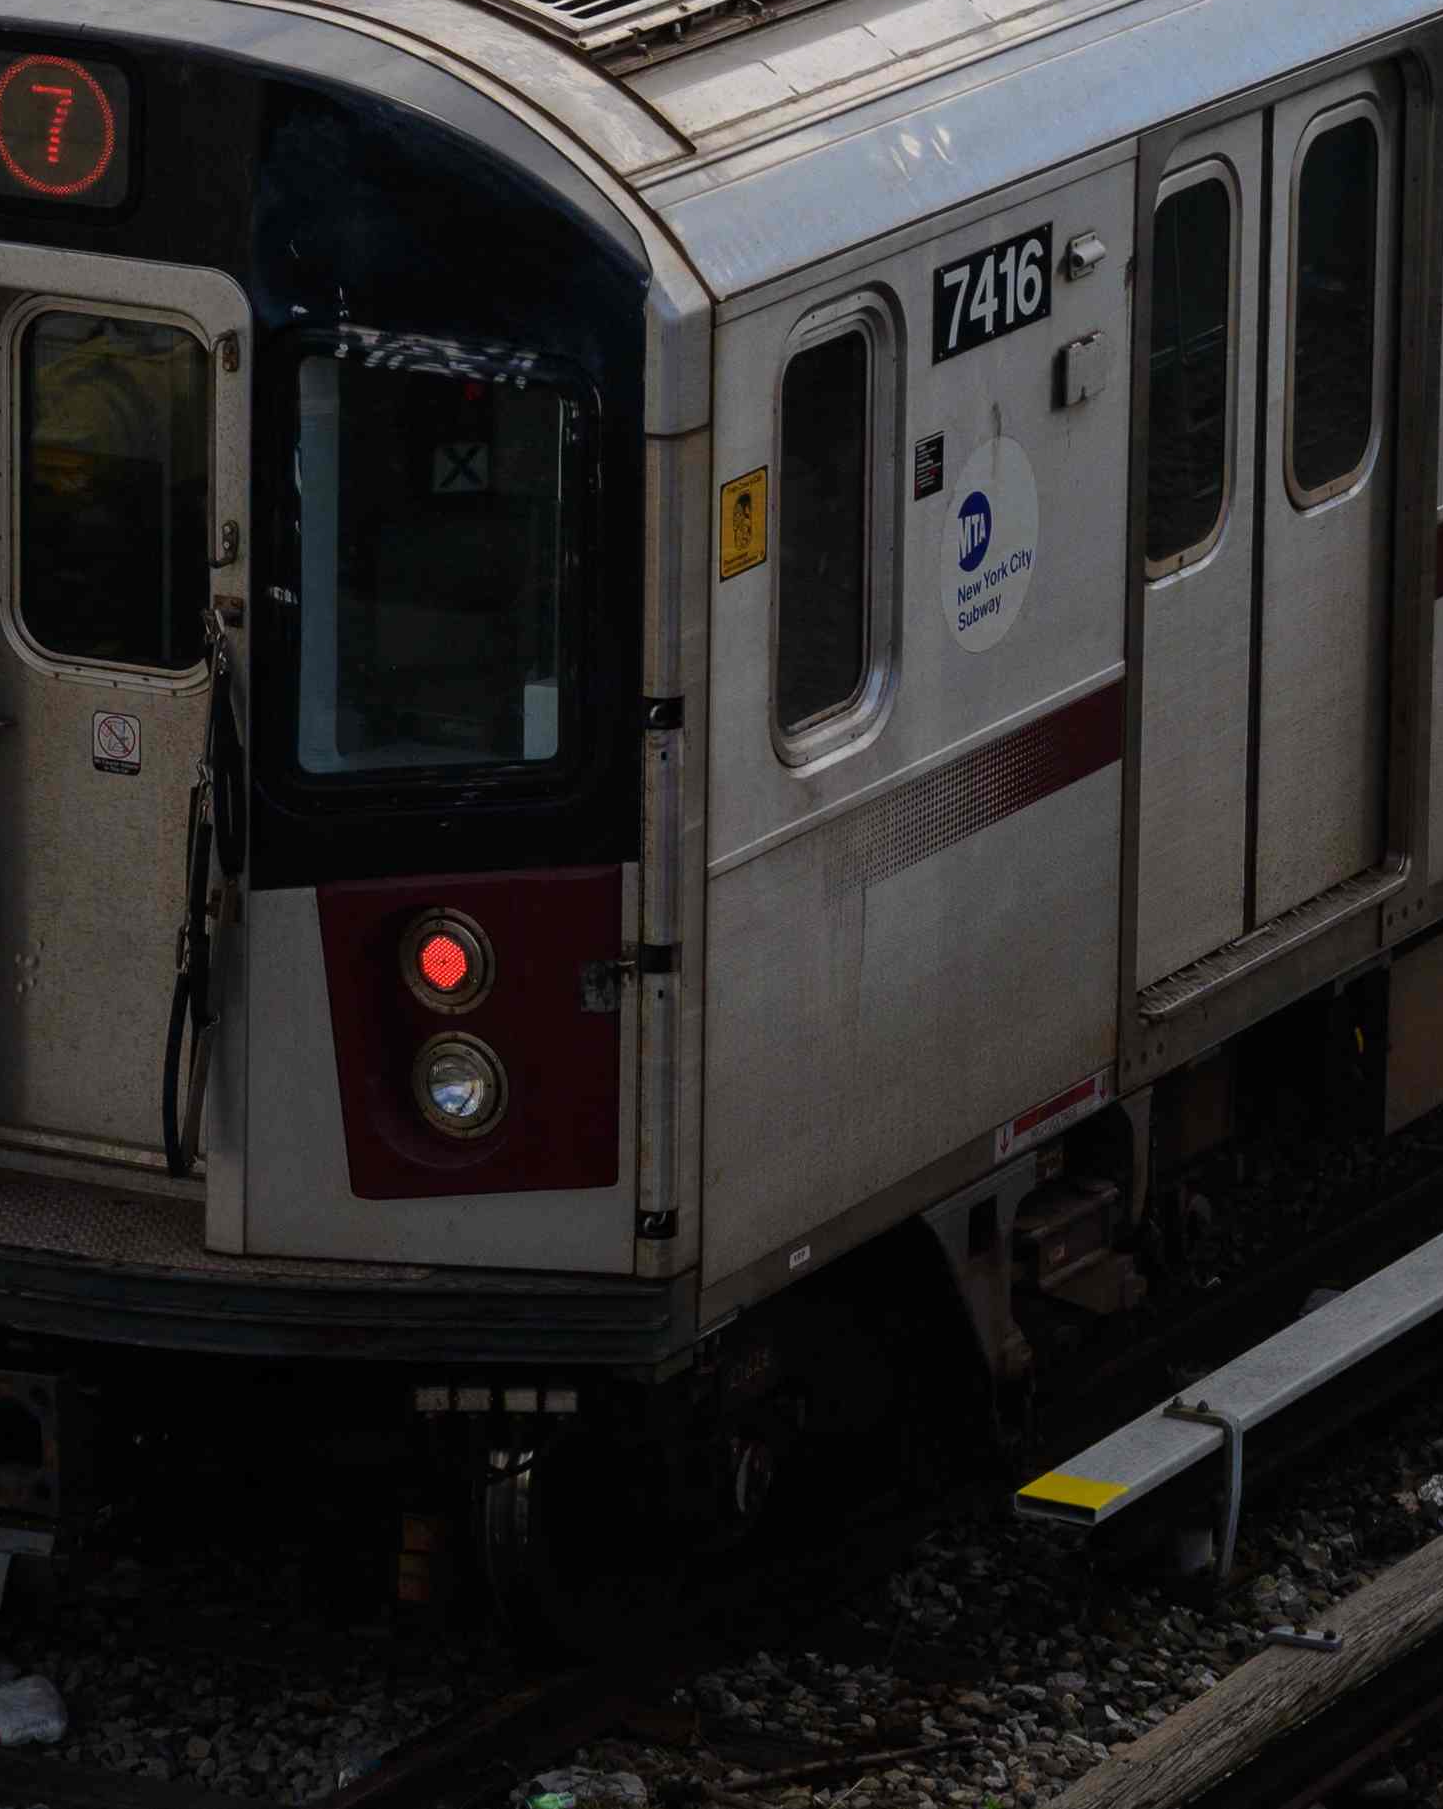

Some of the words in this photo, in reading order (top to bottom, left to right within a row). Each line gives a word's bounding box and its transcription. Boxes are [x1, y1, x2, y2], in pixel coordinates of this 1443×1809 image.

[32, 84, 73, 166] 7
[943, 239, 1042, 348] 7416
[957, 583, 982, 605] New
[985, 565, 1008, 592] York
[1009, 548, 1033, 578] City
[957, 593, 1003, 631] Subway
